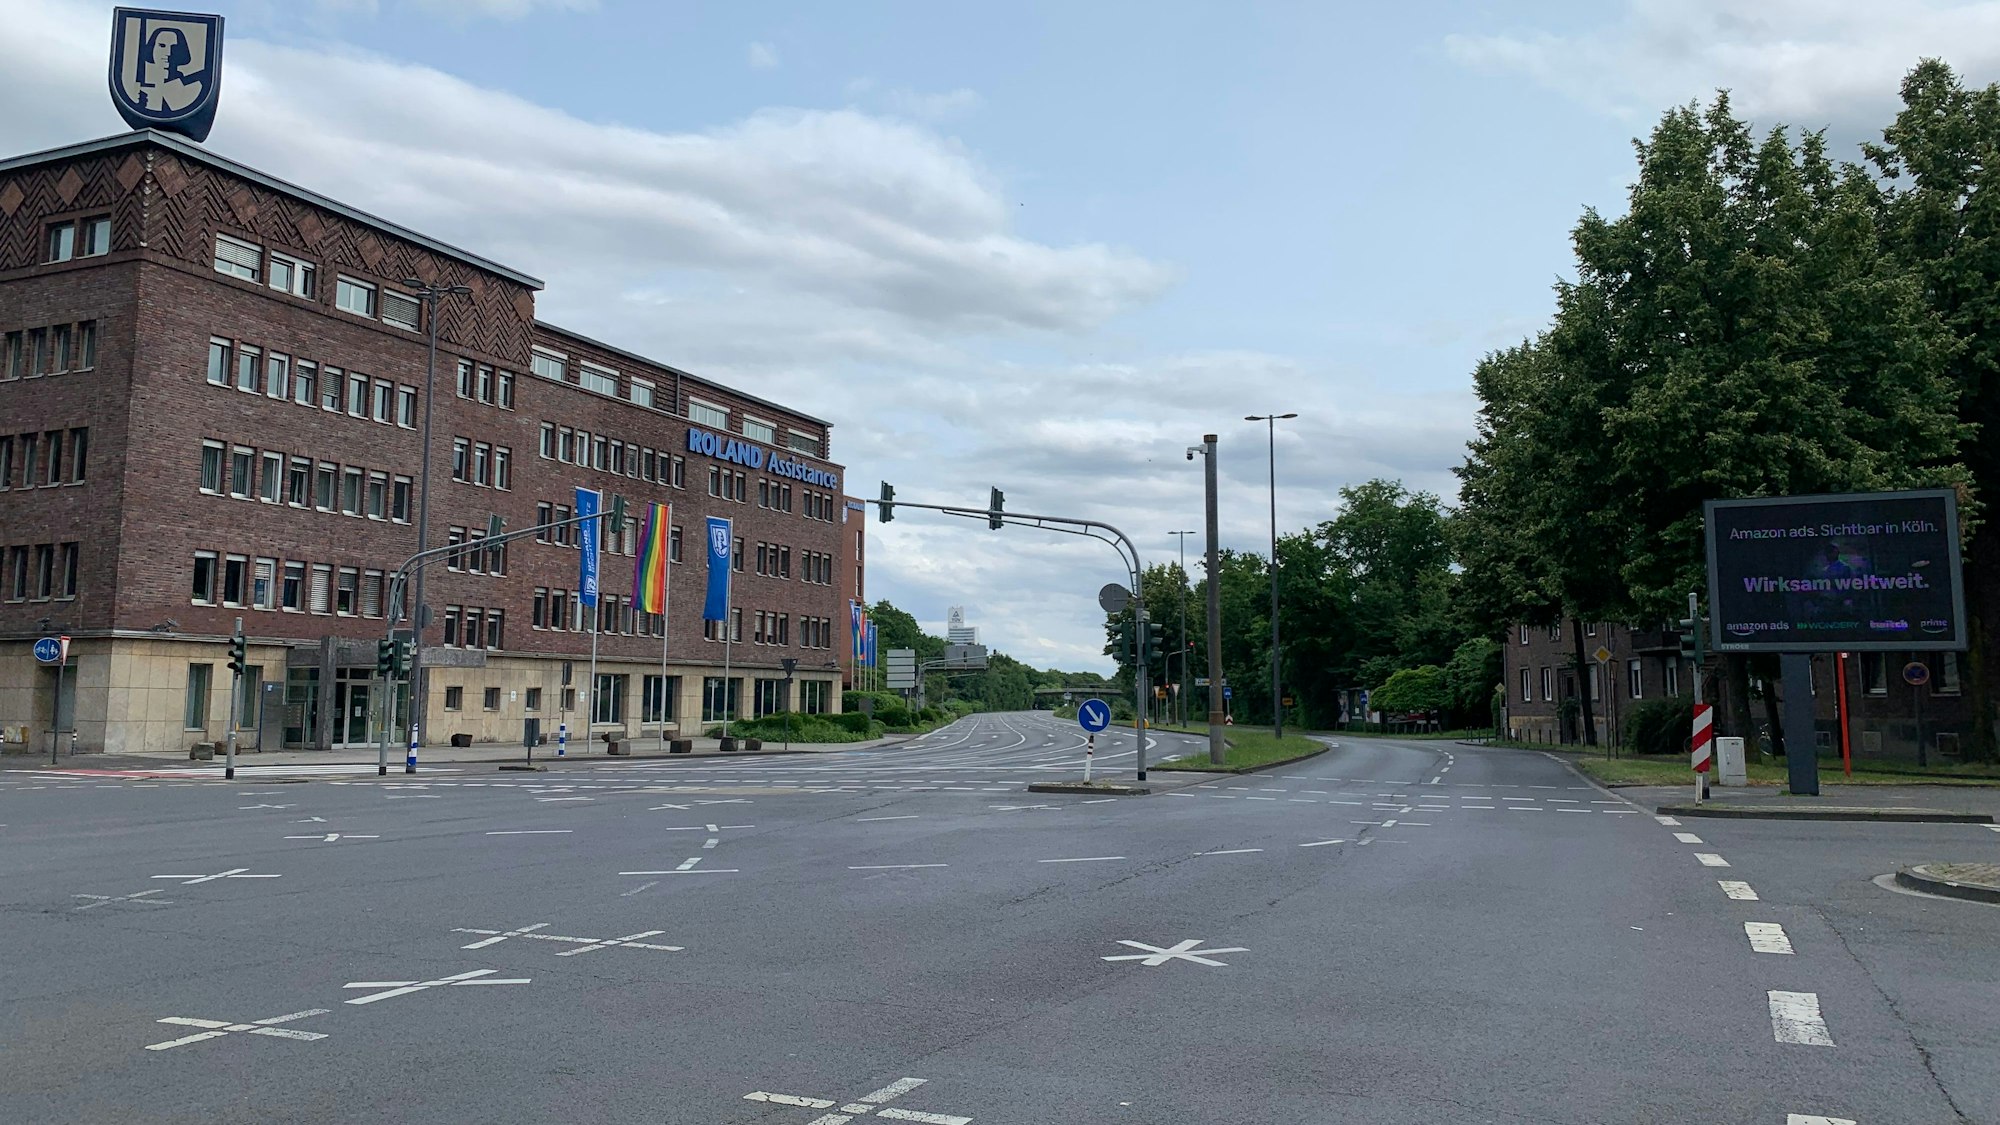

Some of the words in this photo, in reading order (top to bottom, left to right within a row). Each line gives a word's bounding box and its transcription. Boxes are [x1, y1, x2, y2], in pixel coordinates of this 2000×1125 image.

[688, 428, 763, 469] ROLAND
[768, 452, 837, 489] Assistance
[1729, 528, 1786, 540] Amazon
[1789, 526, 1818, 538] ads.
[1820, 523, 1880, 536] Sichtbar
[1885, 522, 1899, 534] in
[1902, 520, 1938, 533] Köln.
[1744, 576, 1831, 592] Wirksam
[1835, 573, 1929, 590] weltweit.
[1726, 622, 1768, 630] amazon
[1770, 621, 1789, 630] ads
[1921, 618, 1948, 628] prime
